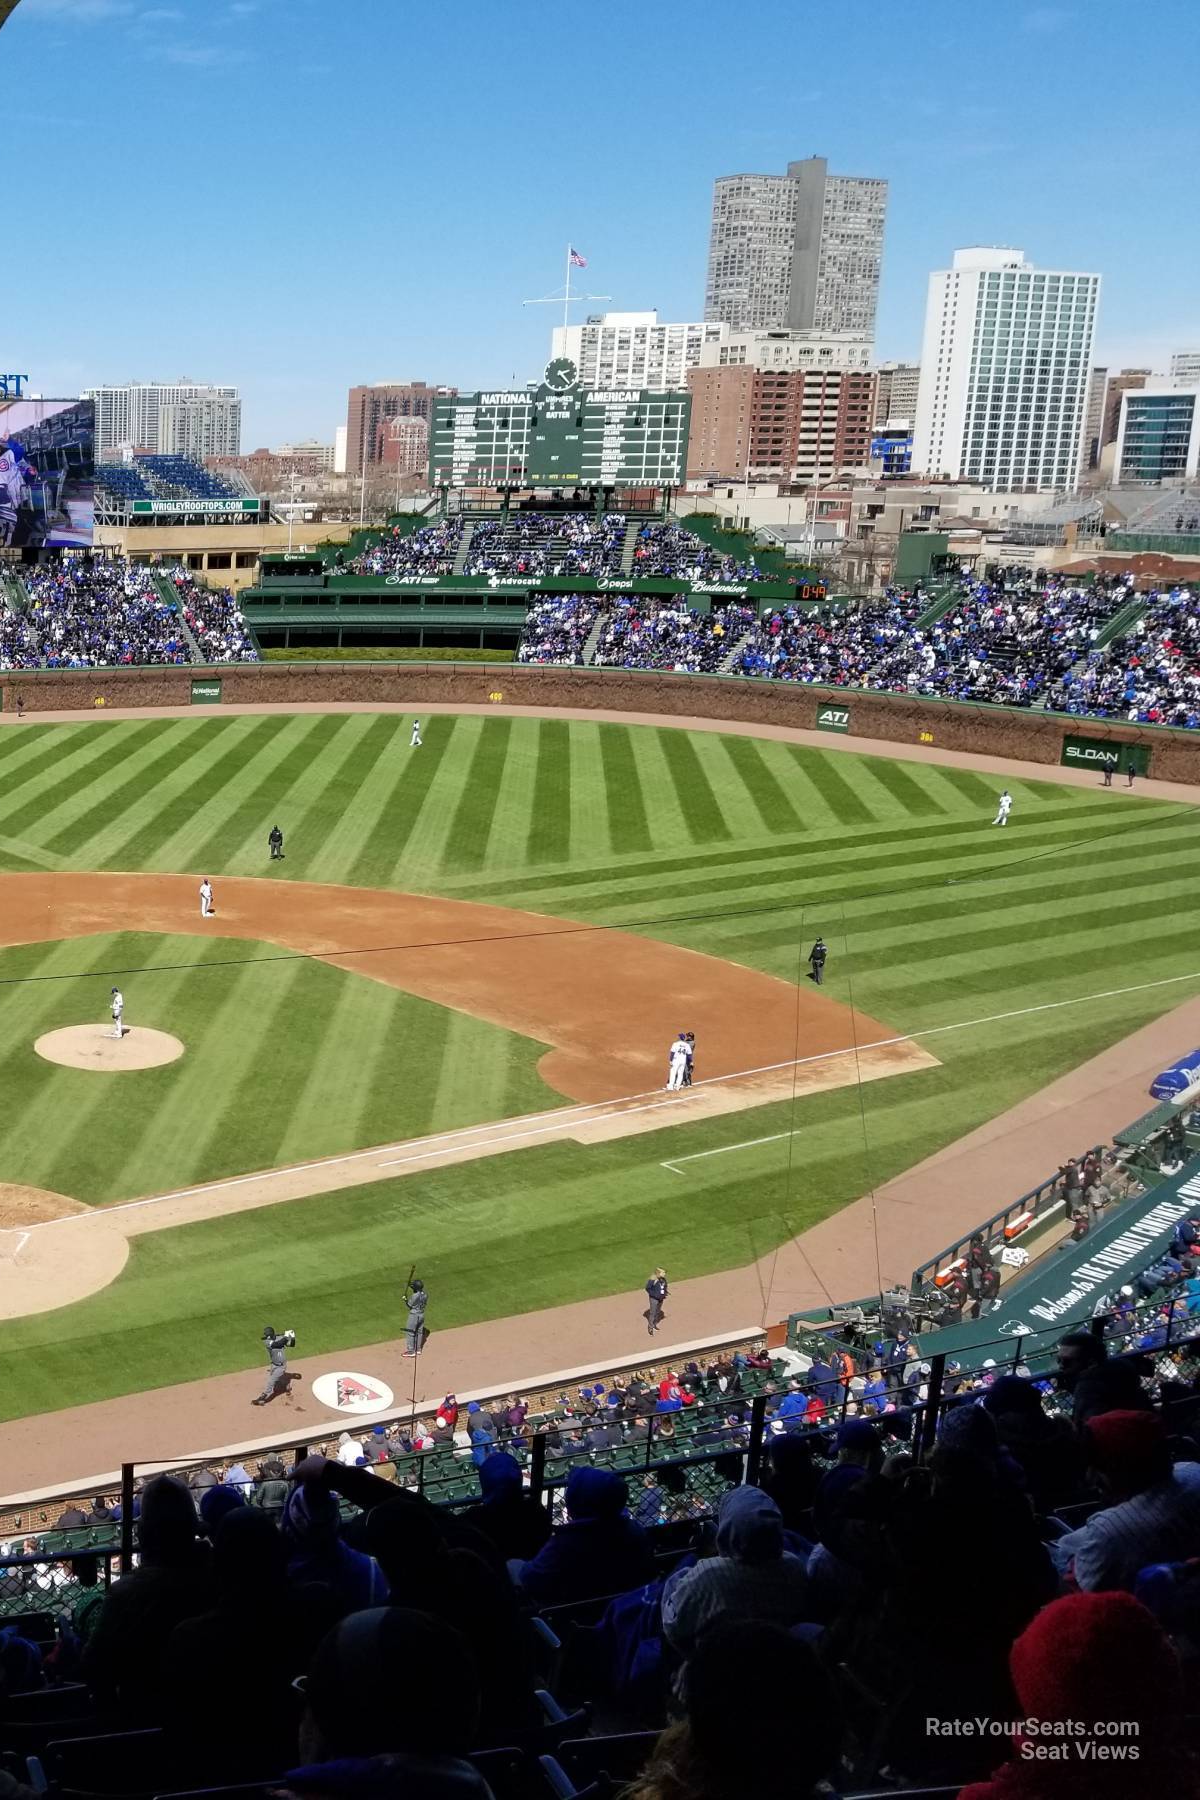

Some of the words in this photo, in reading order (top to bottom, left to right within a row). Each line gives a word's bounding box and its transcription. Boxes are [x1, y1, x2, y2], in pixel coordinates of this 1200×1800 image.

[480, 394, 532, 404] NATIONAL
[586, 392, 640, 402] AMERICAN
[152, 501, 243, 511] WRIGLEYROOFTOPS.COM
[398, 576, 422, 584] ATI
[500, 577, 542, 586] Advocate
[608, 580, 633, 588] pepsi
[691, 580, 748, 593] Budweiser
[802, 586, 826, 599] 0:49
[820, 710, 850, 722] ATI
[1066, 746, 1118, 762] SLOAN
[1130, 1202, 1190, 1237] CONFINES
[1090, 1232, 1152, 1268] FRIENDLY
[1070, 1263, 1114, 1282] THE
[1028, 1288, 1084, 1322] Welcome
